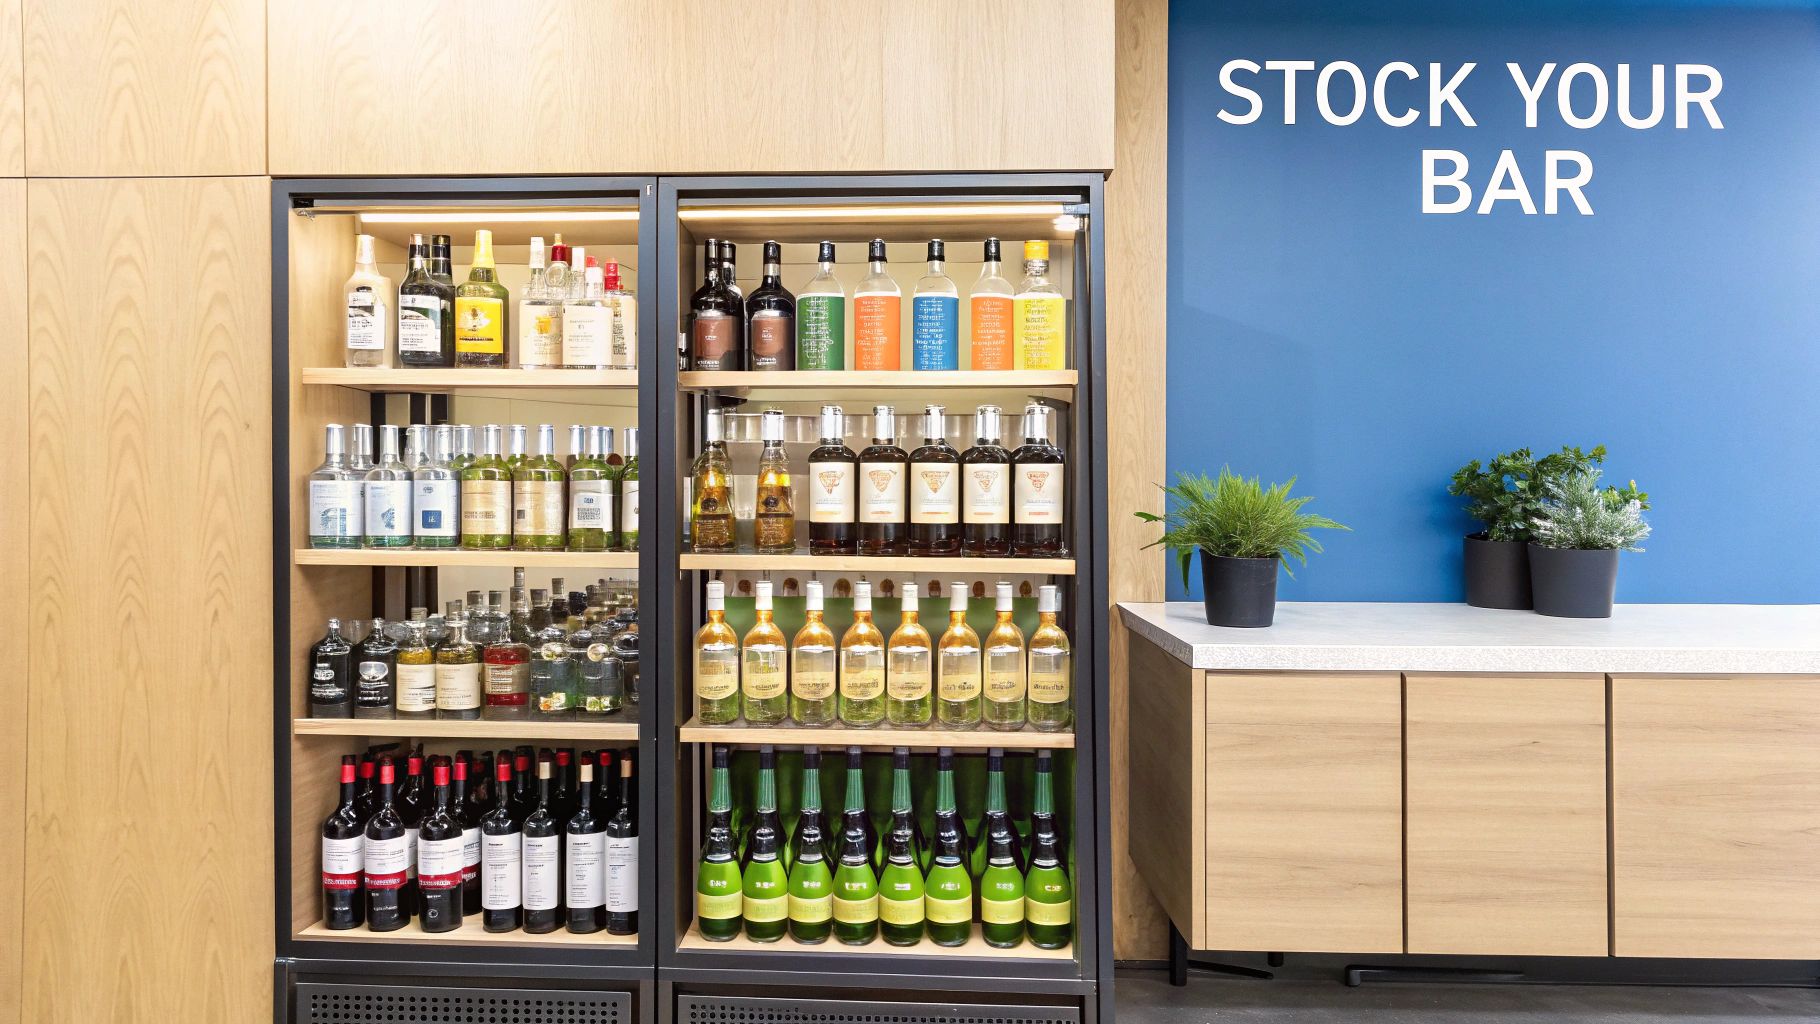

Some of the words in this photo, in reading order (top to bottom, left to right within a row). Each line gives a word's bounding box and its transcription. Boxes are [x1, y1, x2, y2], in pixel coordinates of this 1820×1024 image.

[1216, 59, 1478, 127] STOCK
[1506, 62, 1725, 130] YOUR
[1422, 149, 1595, 216] BAR
